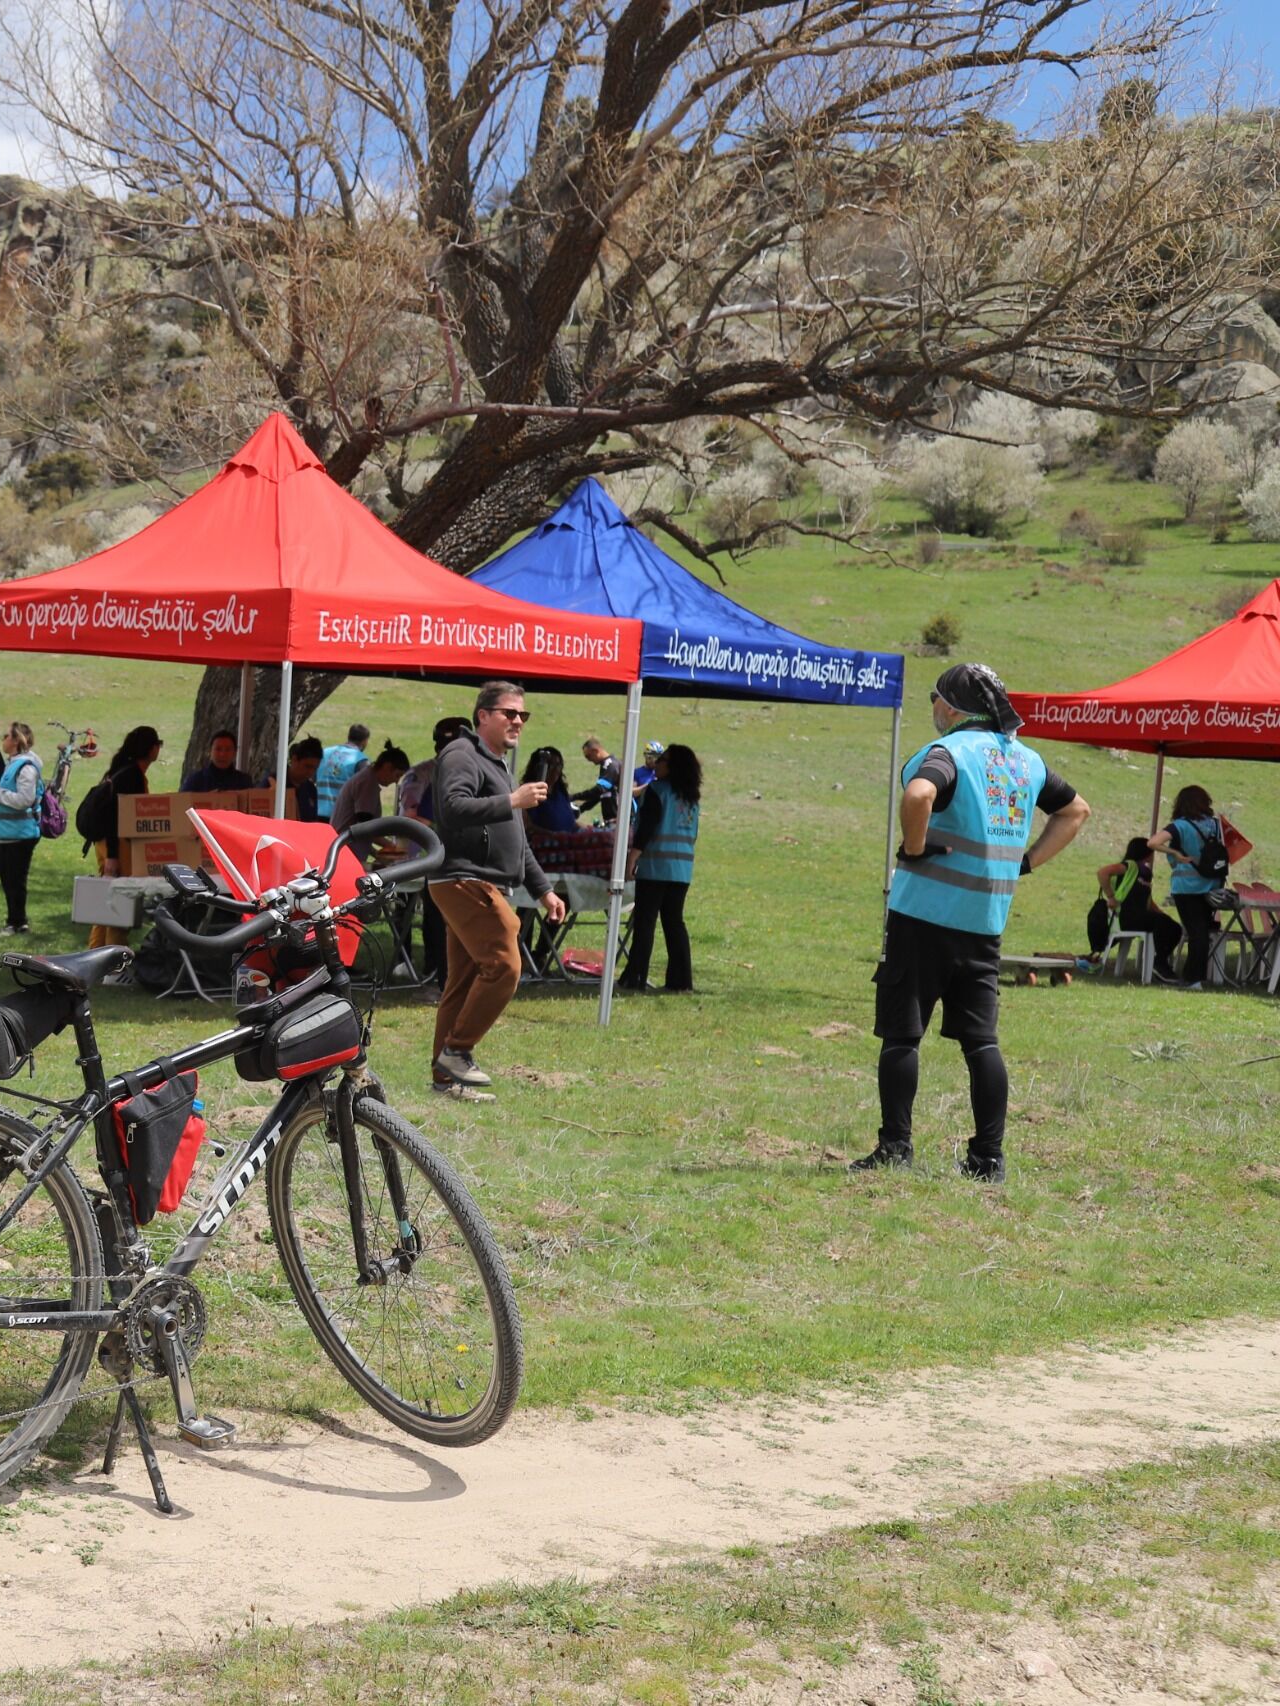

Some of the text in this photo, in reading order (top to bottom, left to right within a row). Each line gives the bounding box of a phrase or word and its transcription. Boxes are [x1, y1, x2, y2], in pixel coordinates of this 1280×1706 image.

[26, 596, 89, 640] gerçeğe
[92, 591, 199, 646] dönüştüğü
[202, 594, 258, 640] şehir
[664, 628, 888, 696] Hayallerin gerçeğe dönüştüğü şehir
[1029, 697, 1132, 731] Hayallerin
[1136, 704, 1200, 734] gerçeğe
[136, 819, 171, 832] GALETA
[199, 1120, 283, 1236] SCOTT
[16, 1316, 49, 1325] SCOTT
